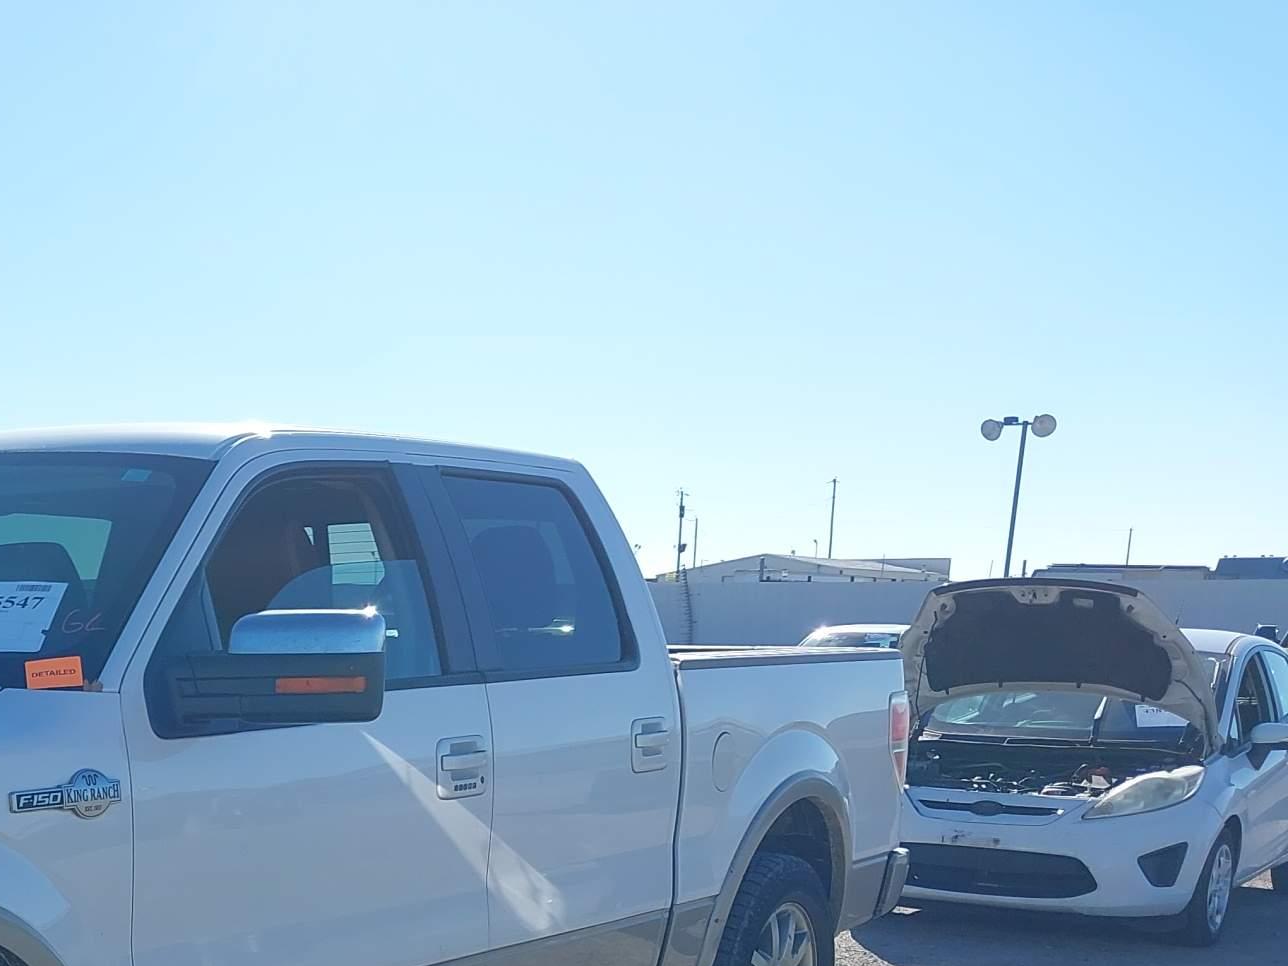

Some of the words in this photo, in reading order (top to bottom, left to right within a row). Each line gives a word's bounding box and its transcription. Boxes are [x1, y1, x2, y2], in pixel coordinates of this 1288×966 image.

[31, 668, 76, 679] DETAILED
[18, 792, 61, 808] F-150
[66, 787, 88, 804] KING
[90, 783, 119, 801] RANCH
